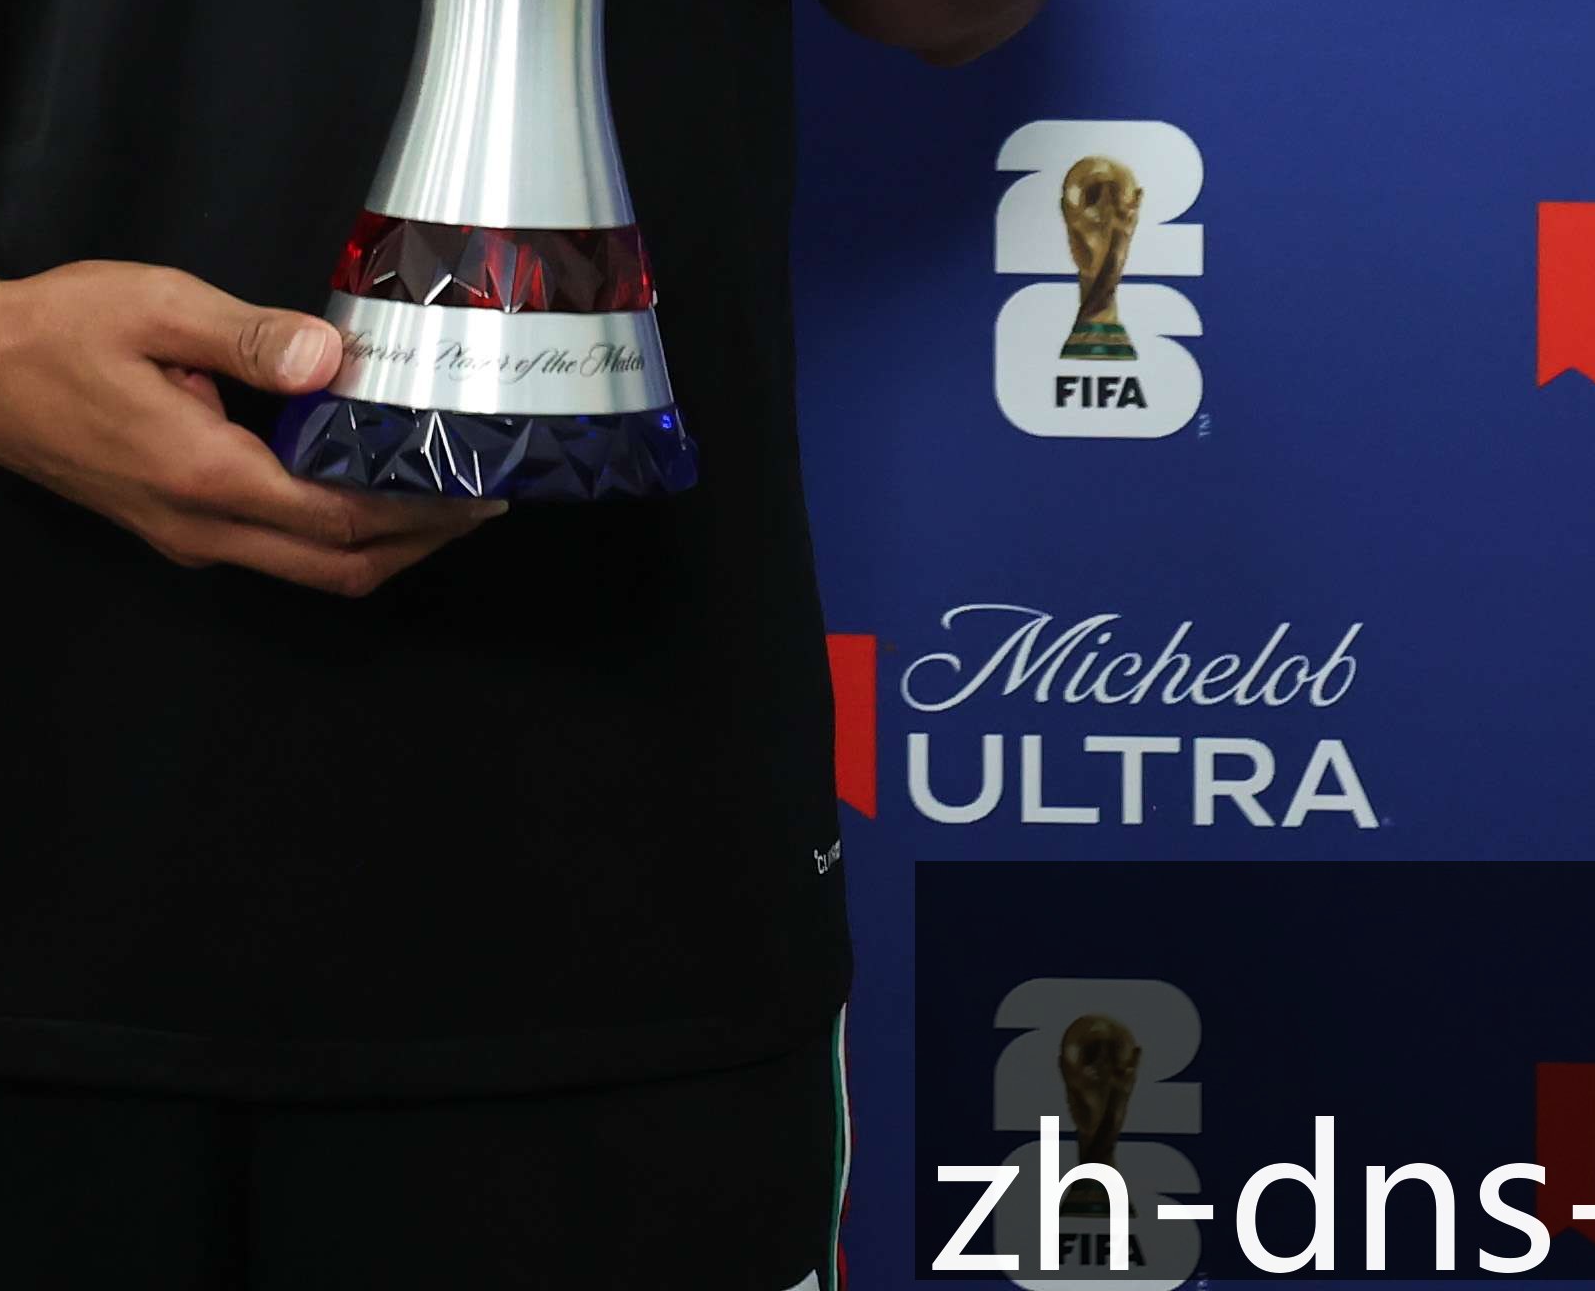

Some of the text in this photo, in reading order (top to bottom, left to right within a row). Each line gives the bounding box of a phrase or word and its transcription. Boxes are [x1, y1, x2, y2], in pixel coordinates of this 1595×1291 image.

[542, 347, 578, 375] the
[579, 340, 646, 379] Match
[1056, 376, 1146, 408] FIFA
[902, 604, 1363, 711] Michelob
[908, 733, 1379, 828] ULTRA
